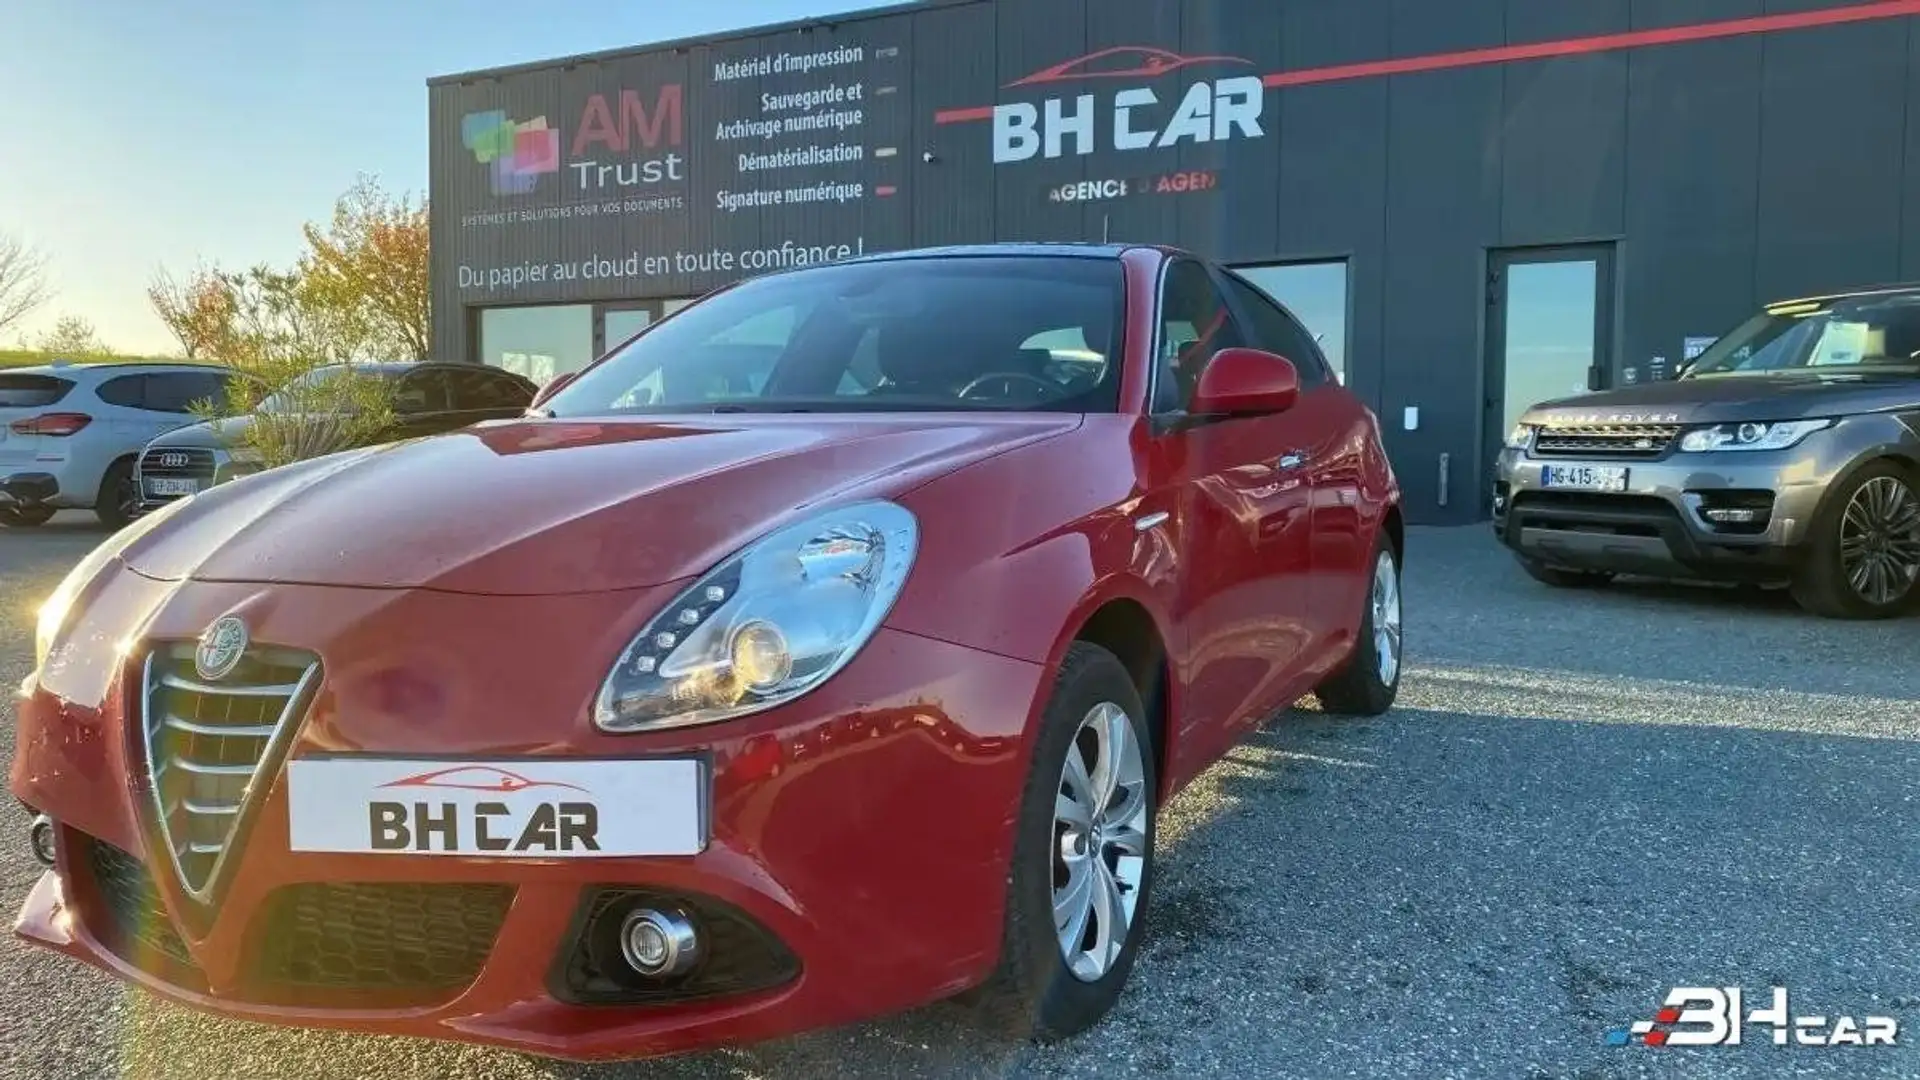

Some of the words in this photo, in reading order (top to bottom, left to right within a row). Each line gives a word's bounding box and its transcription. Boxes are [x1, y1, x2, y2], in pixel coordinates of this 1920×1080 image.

[714, 58, 771, 82] Matériel
[773, 45, 863, 74] d'impression
[761, 84, 844, 112] Sauvegarde
[847, 83, 863, 101] et
[572, 83, 682, 157] AM
[716, 118, 782, 140] Archivage
[784, 108, 863, 131] numérique
[992, 93, 1094, 164] BH
[1113, 75, 1265, 151] CAR
[569, 153, 683, 190] Trust
[738, 143, 863, 172] Dématérialisation
[521, 206, 571, 221] SOLUTIONS
[574, 204, 600, 217] POUR
[601, 201, 621, 213] VOS
[624, 196, 684, 212] DOCUMENTS
[716, 186, 782, 212] Signature
[784, 181, 864, 203] numérique
[459, 265, 483, 288] Du
[489, 261, 548, 292] papier
[553, 263, 576, 282] au
[582, 252, 638, 279] cloud
[644, 257, 669, 276] en
[676, 249, 734, 273] toute
[740, 240, 850, 269] confiance
[369, 801, 458, 852] BH
[474, 801, 601, 852] CAR
